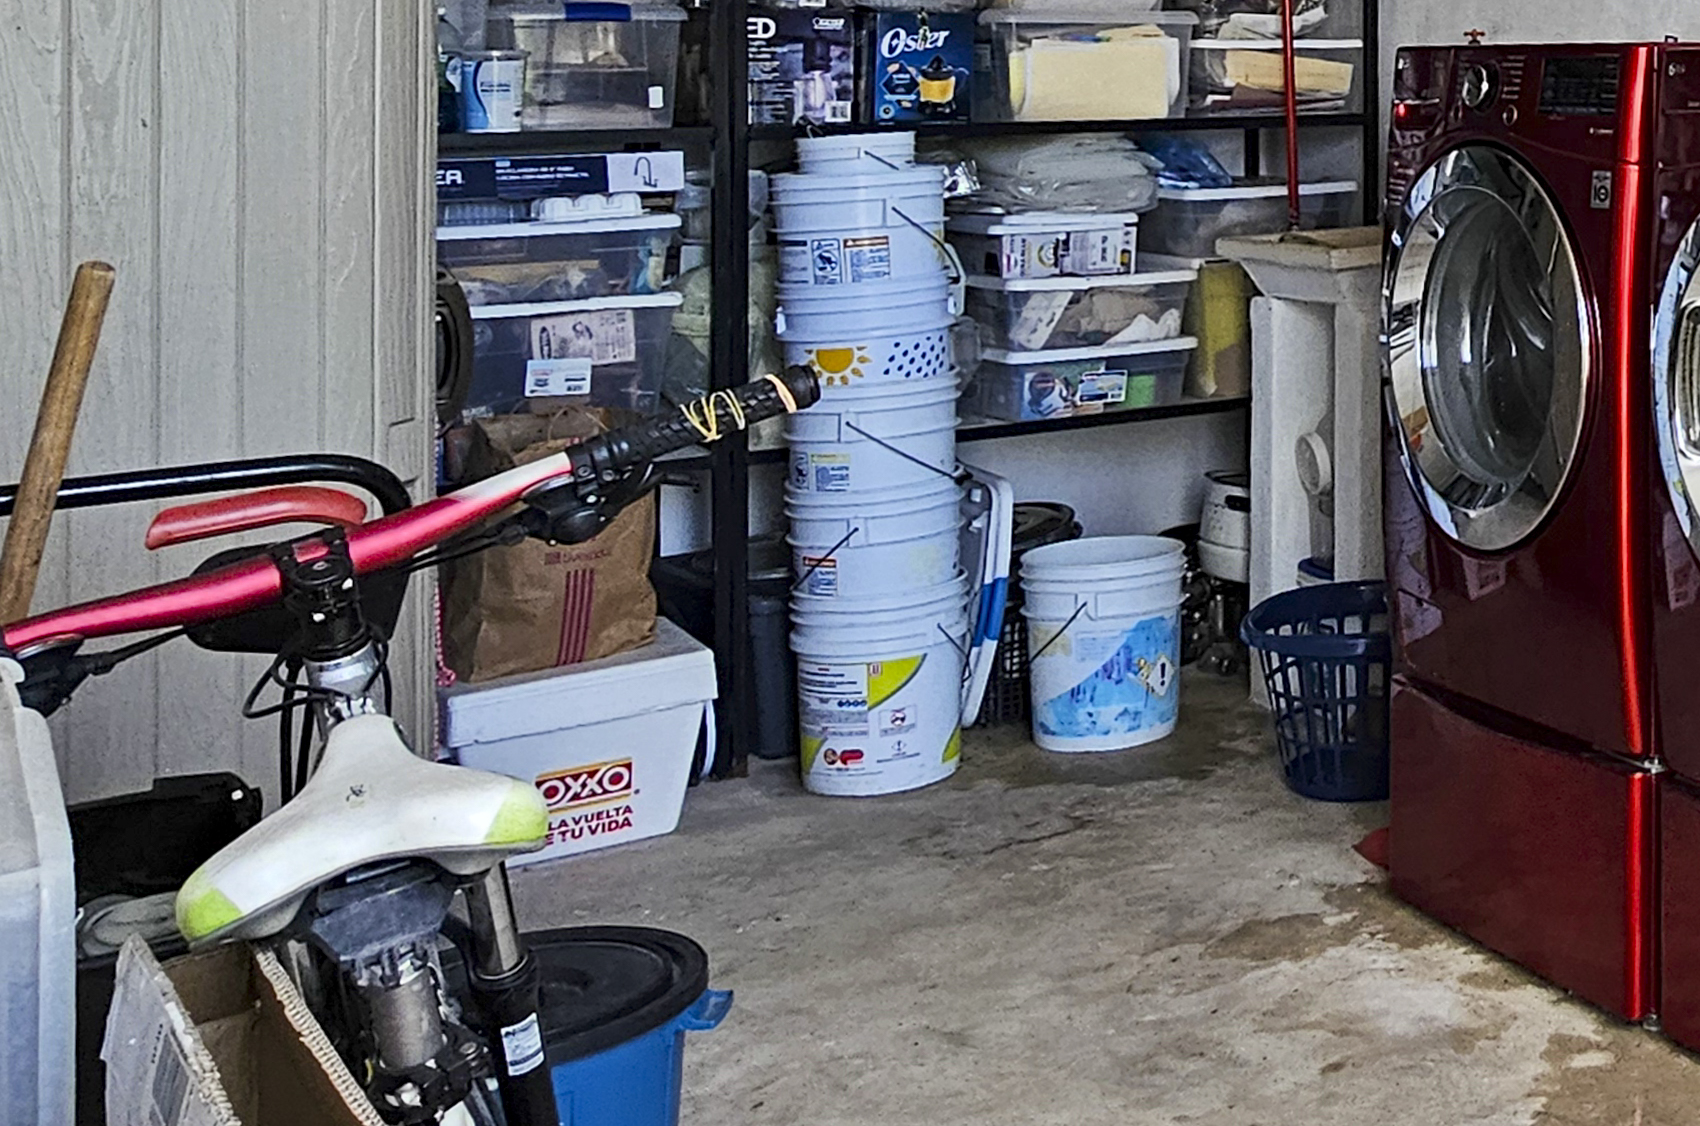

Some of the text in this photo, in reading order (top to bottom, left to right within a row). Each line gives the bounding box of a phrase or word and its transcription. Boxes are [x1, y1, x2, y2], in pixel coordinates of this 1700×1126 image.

[747, 17, 776, 39] ED
[540, 765, 631, 806] OXXO
[548, 805, 633, 832] LA VUELTA
[557, 826, 583, 843] TU
[588, 816, 633, 836] VIDA
